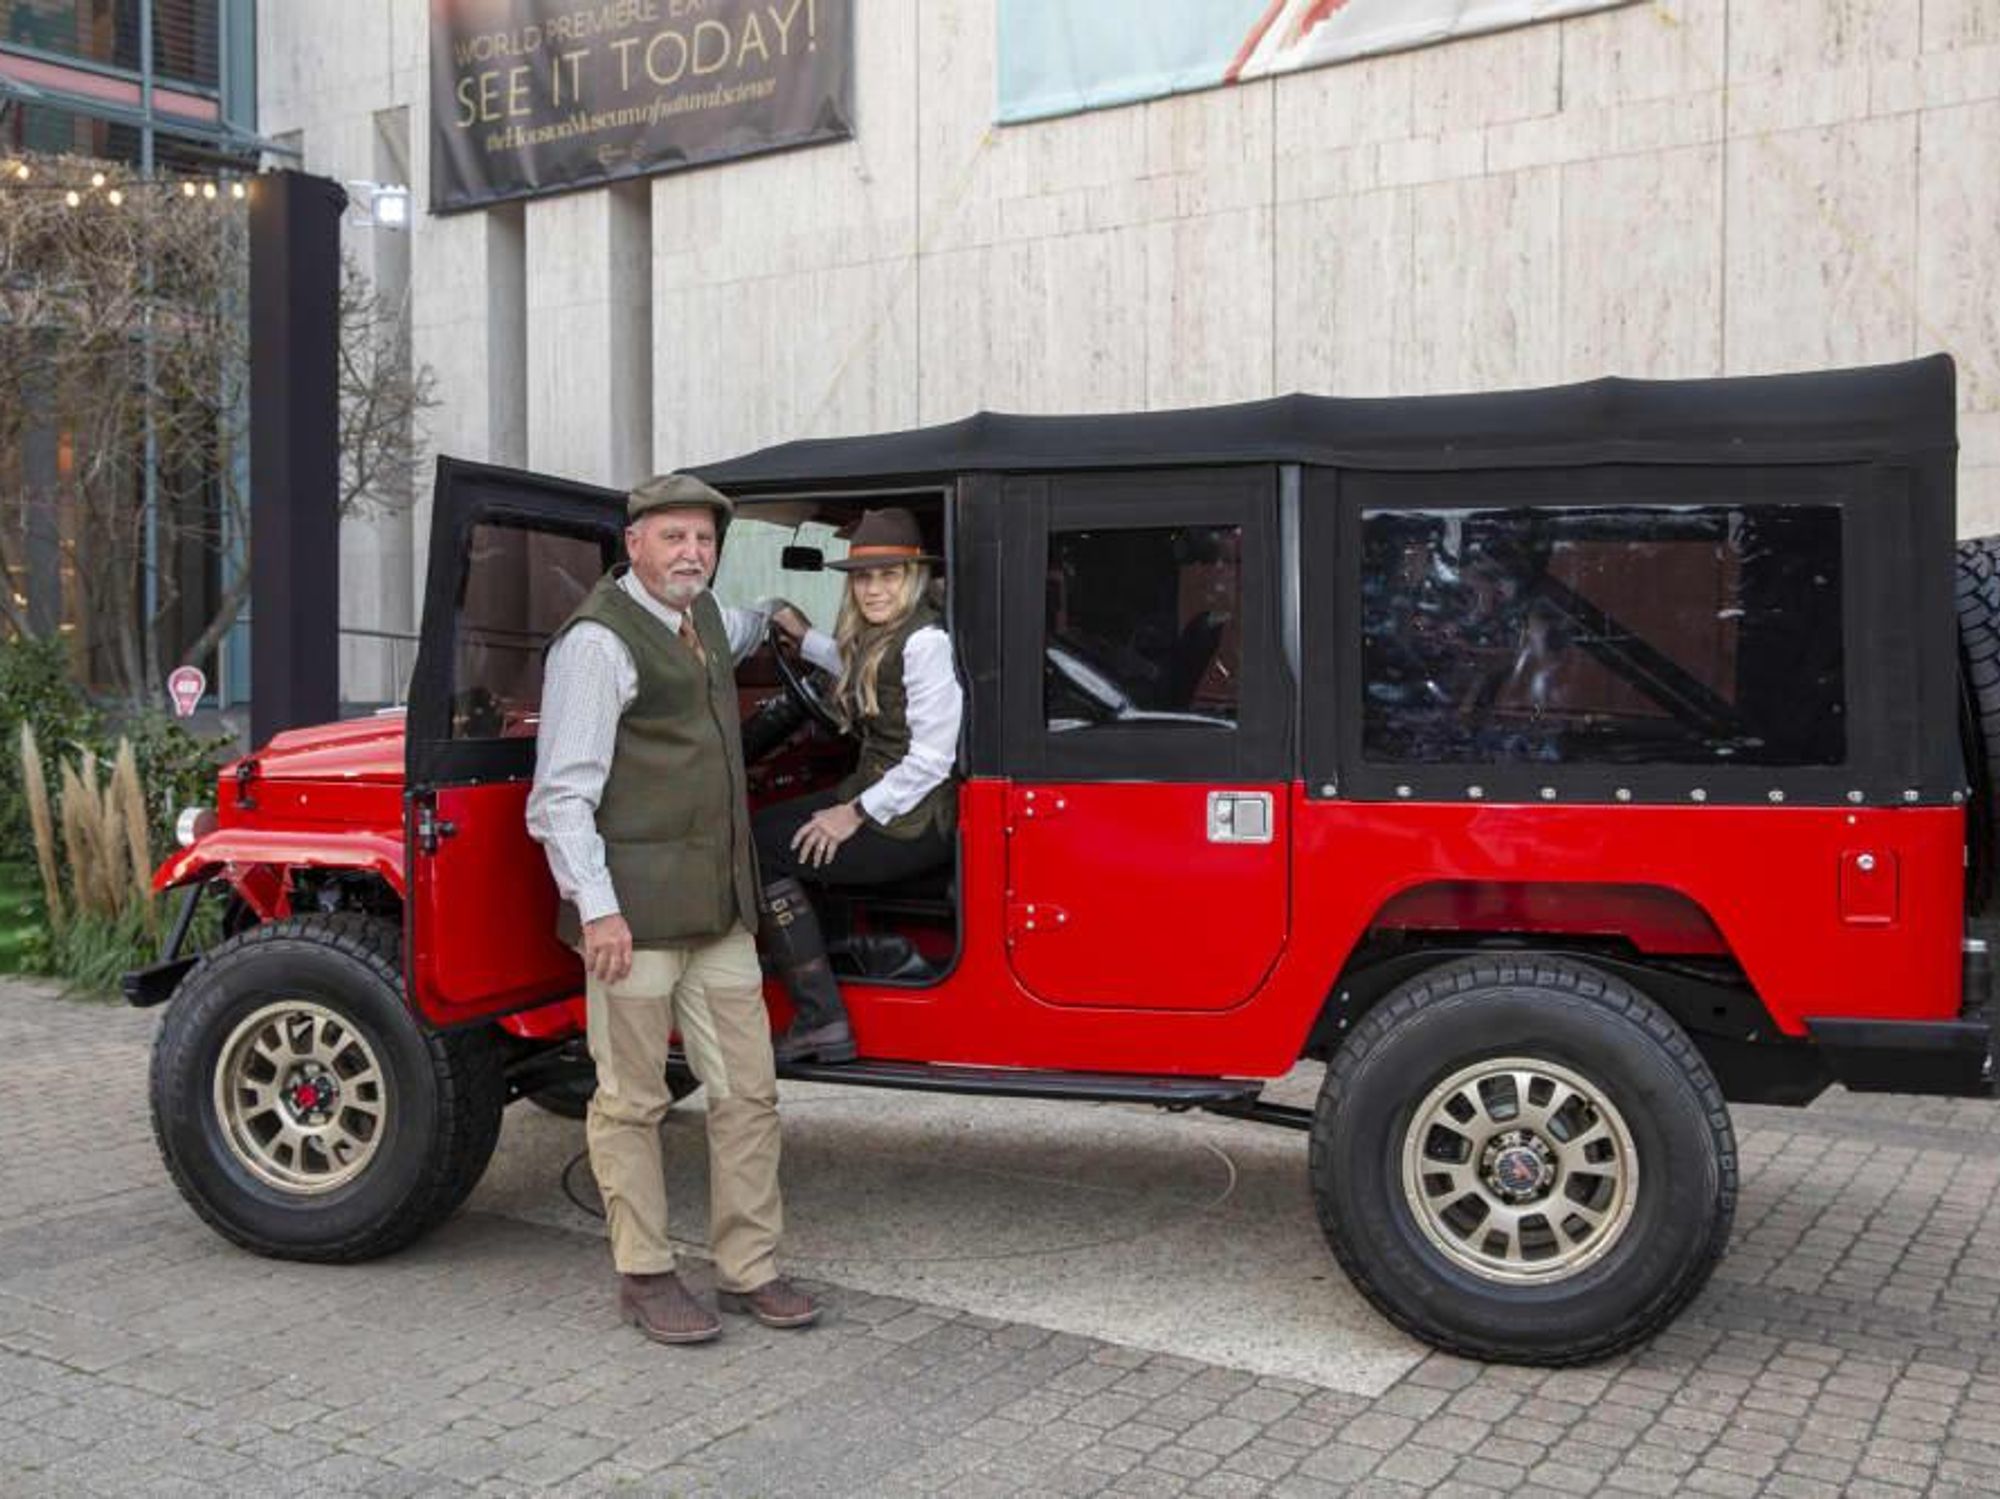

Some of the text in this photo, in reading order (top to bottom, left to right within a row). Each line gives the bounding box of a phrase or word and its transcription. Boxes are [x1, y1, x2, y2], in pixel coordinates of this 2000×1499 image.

[455, 26, 542, 65] WORLD
[546, 1, 658, 41] PREMIERE
[456, 0, 817, 128] SEE IT TODAY!
